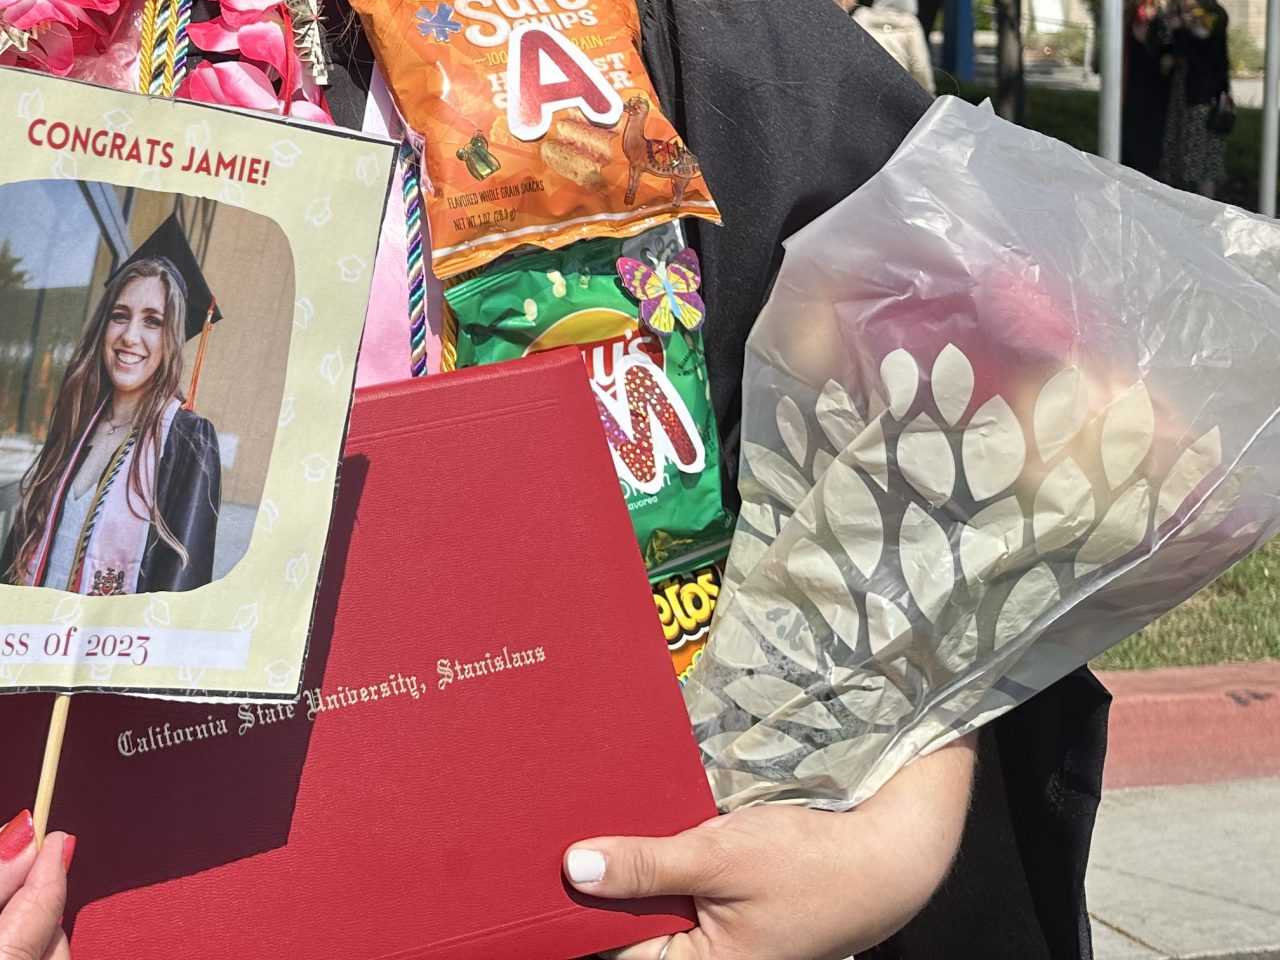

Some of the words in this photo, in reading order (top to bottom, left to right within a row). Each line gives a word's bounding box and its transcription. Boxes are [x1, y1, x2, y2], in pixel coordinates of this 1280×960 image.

[514, 27, 618, 135] A
[28, 118, 174, 169] CONGRATS
[181, 147, 270, 186] JAMIE!
[447, 193, 479, 209] FLAVORED
[480, 188, 500, 203] WHOLE
[500, 183, 521, 199] GRAIN
[521, 179, 545, 194] SNACKS
[453, 217, 467, 231] NET
[44, 627, 78, 656] of
[85, 634, 150, 666] 2023
[118, 715, 228, 757] California
[237, 702, 296, 736] State
[304, 674, 426, 720] University,
[436, 644, 546, 690] Stanislaus
